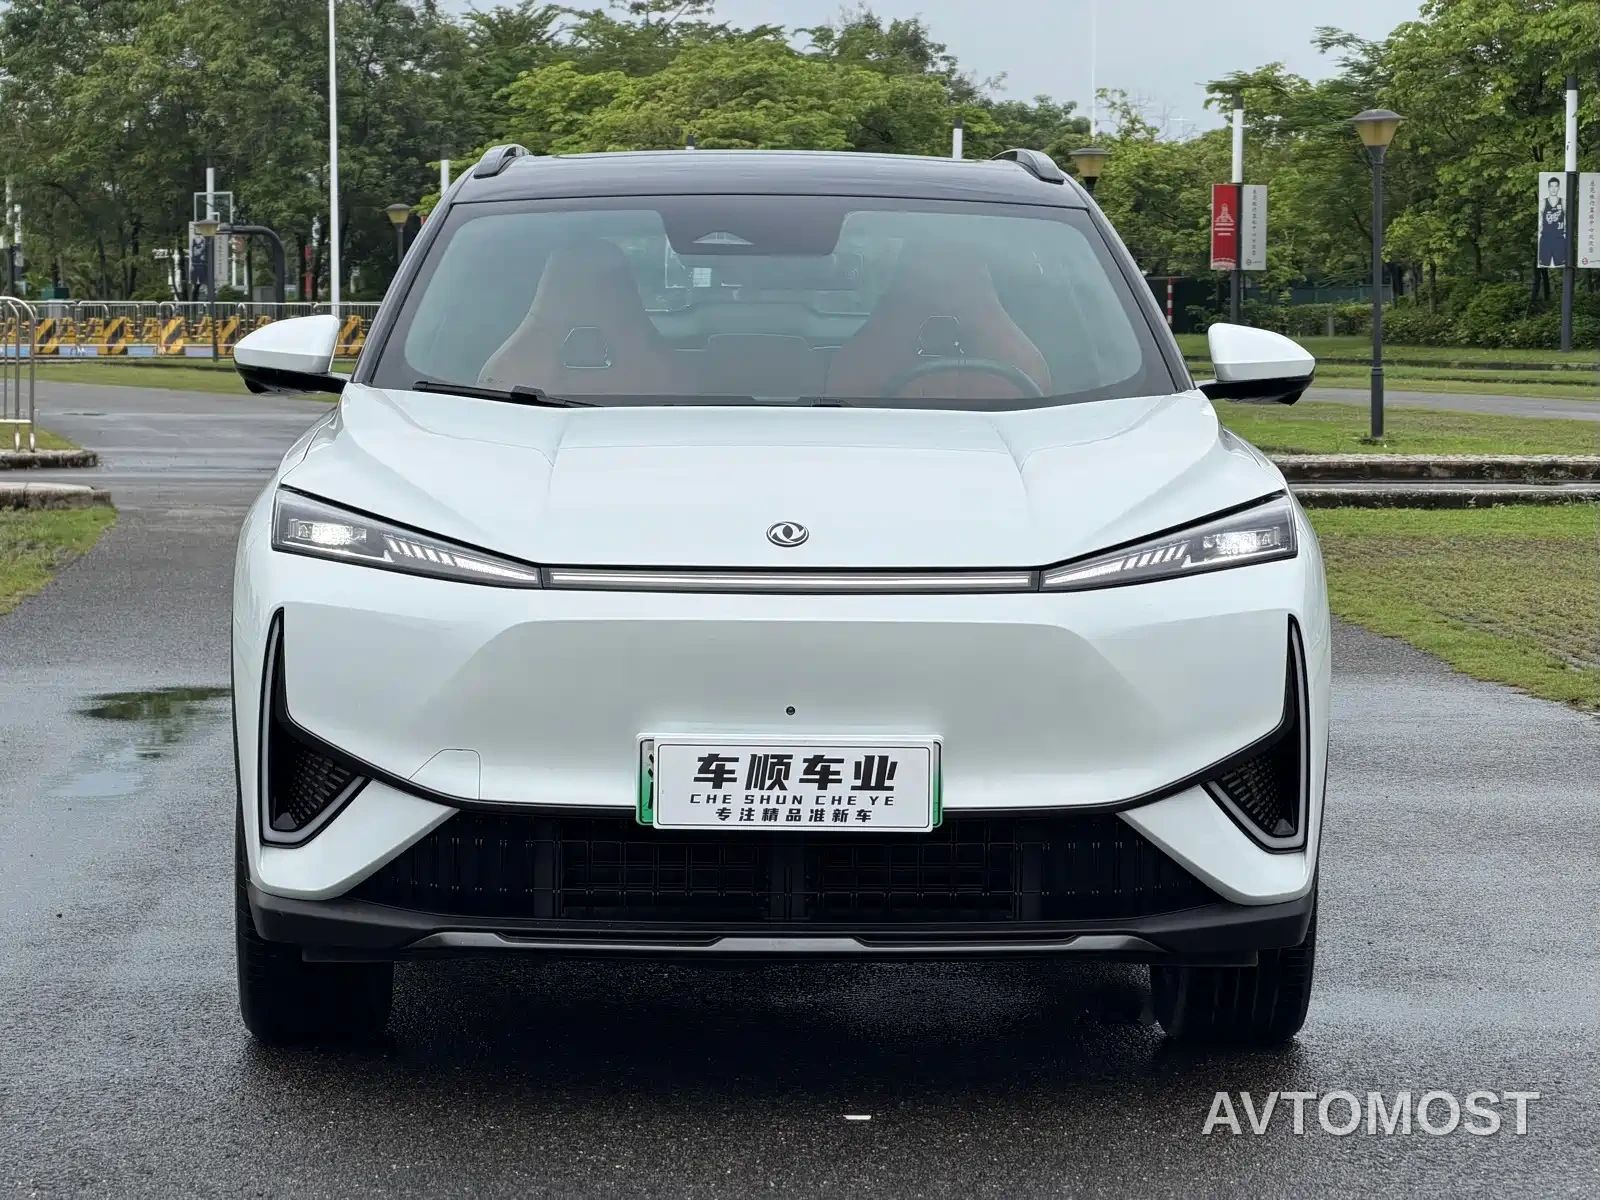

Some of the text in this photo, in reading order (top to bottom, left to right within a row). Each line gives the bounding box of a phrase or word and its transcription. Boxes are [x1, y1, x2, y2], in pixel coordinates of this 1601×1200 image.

[693, 753, 898, 792] 车顺车业
[690, 794, 895, 806] CHE SHUN CHE YE
[715, 807, 872, 823] 专注精品准新车
